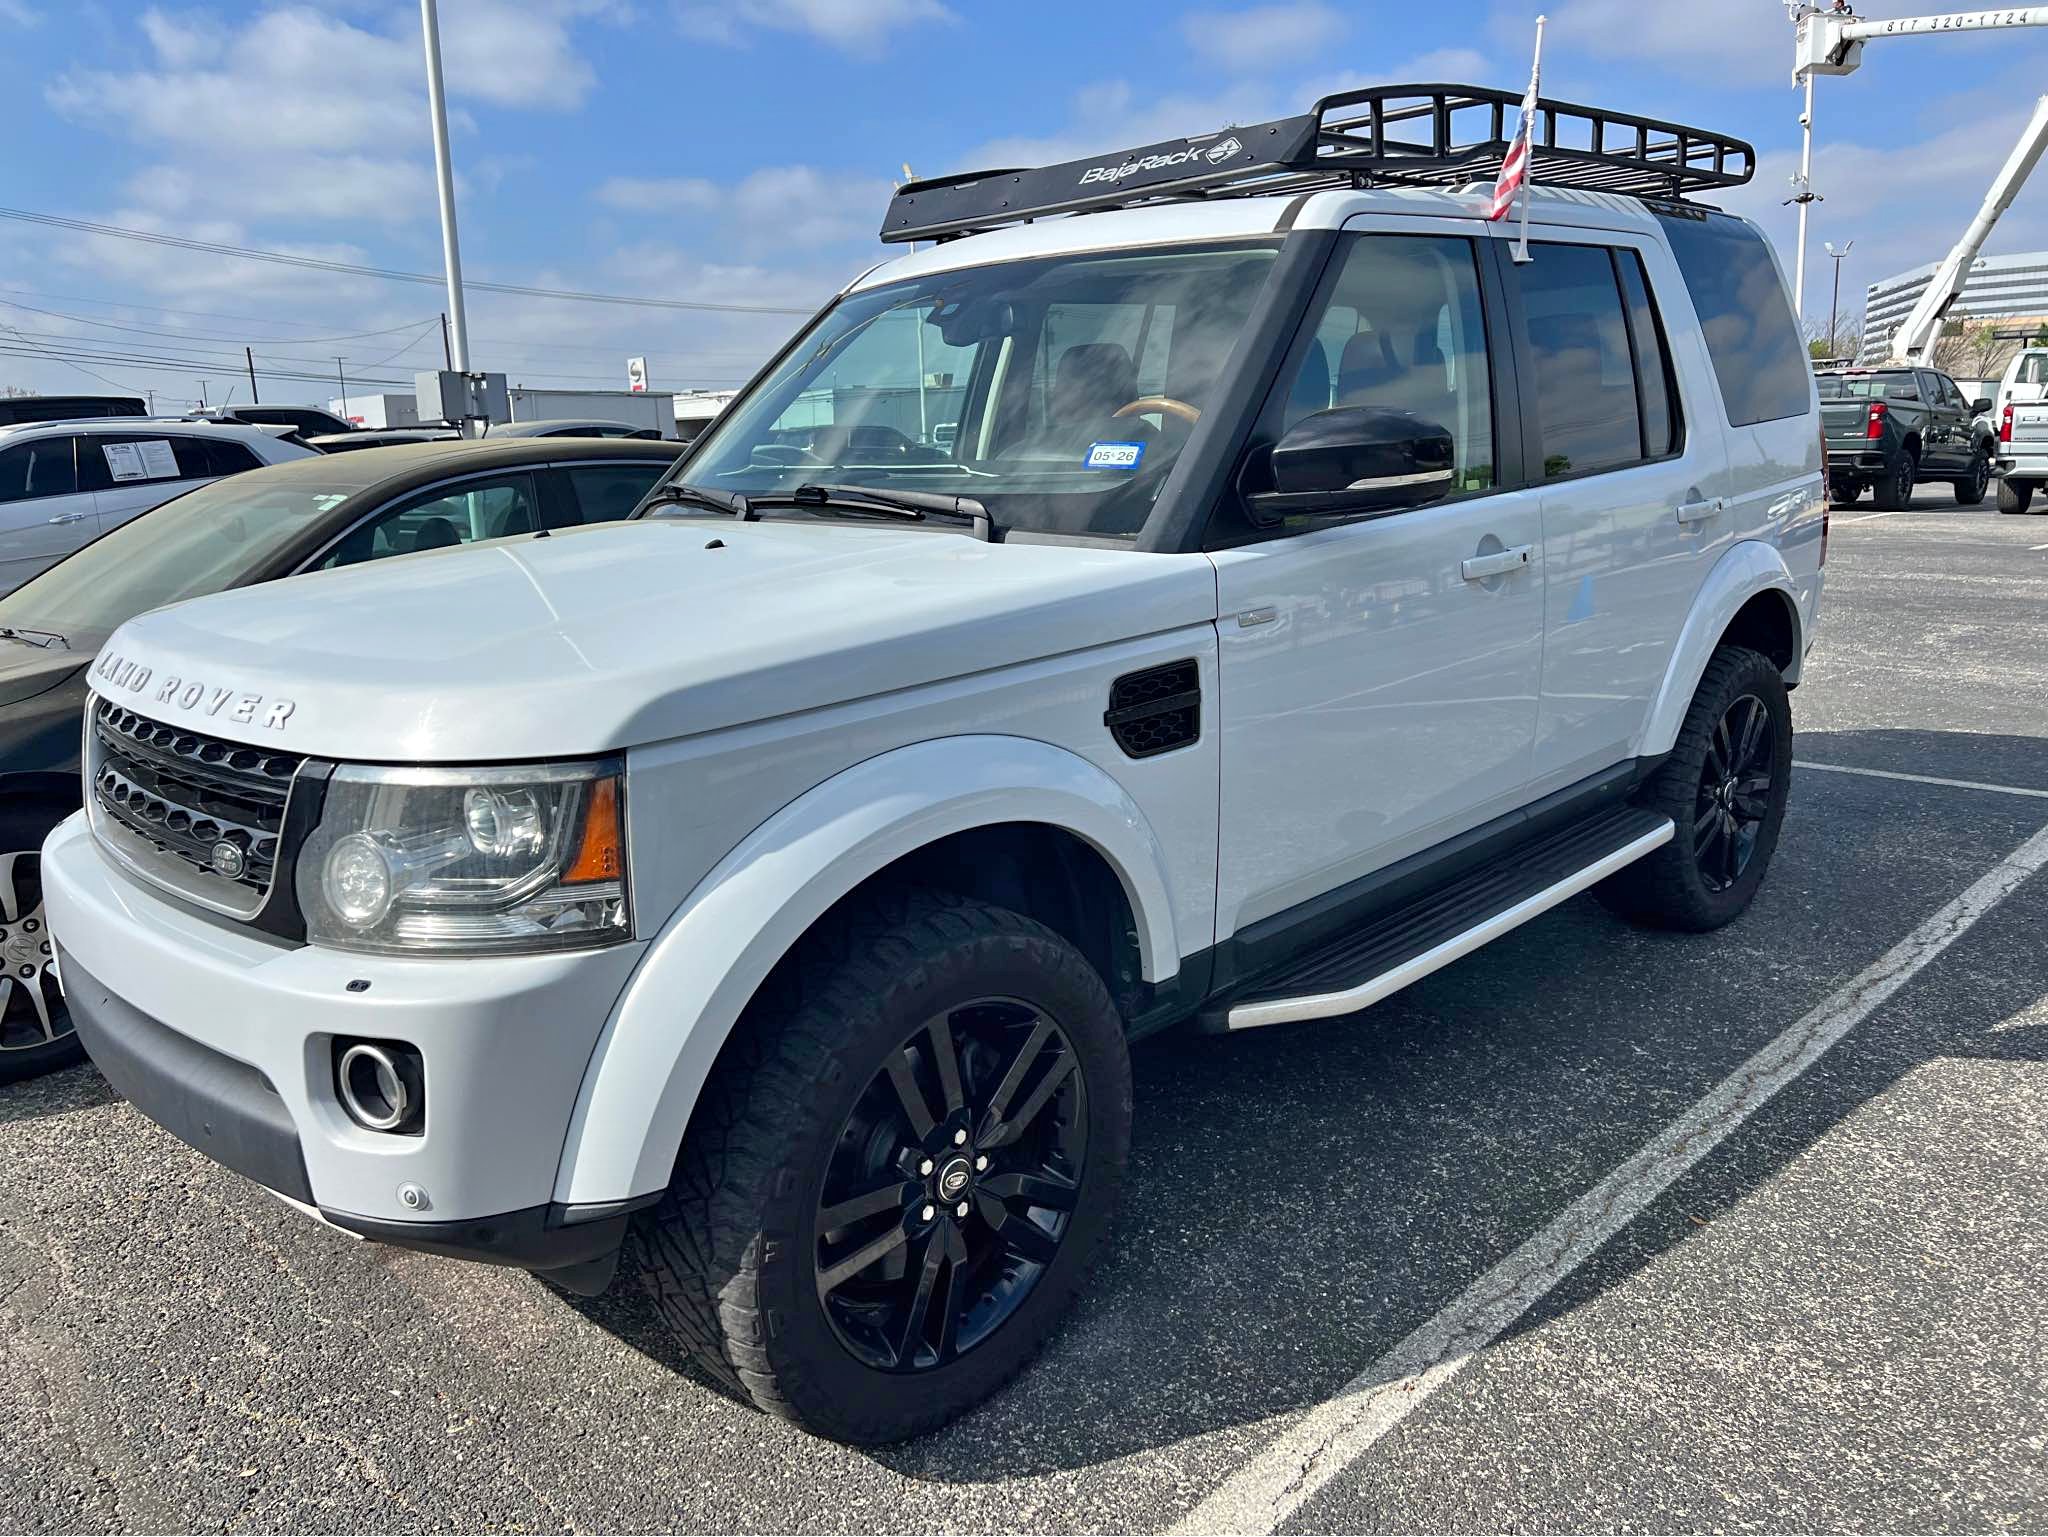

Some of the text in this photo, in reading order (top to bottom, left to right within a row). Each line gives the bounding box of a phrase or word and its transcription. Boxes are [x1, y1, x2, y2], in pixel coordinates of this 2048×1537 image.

[1887, 12, 2029, 32] 817 320-1724
[1079, 146, 1207, 184] BajaRack
[1093, 451, 1135, 461] 05 26
[97, 652, 296, 730] LAND ROVER
